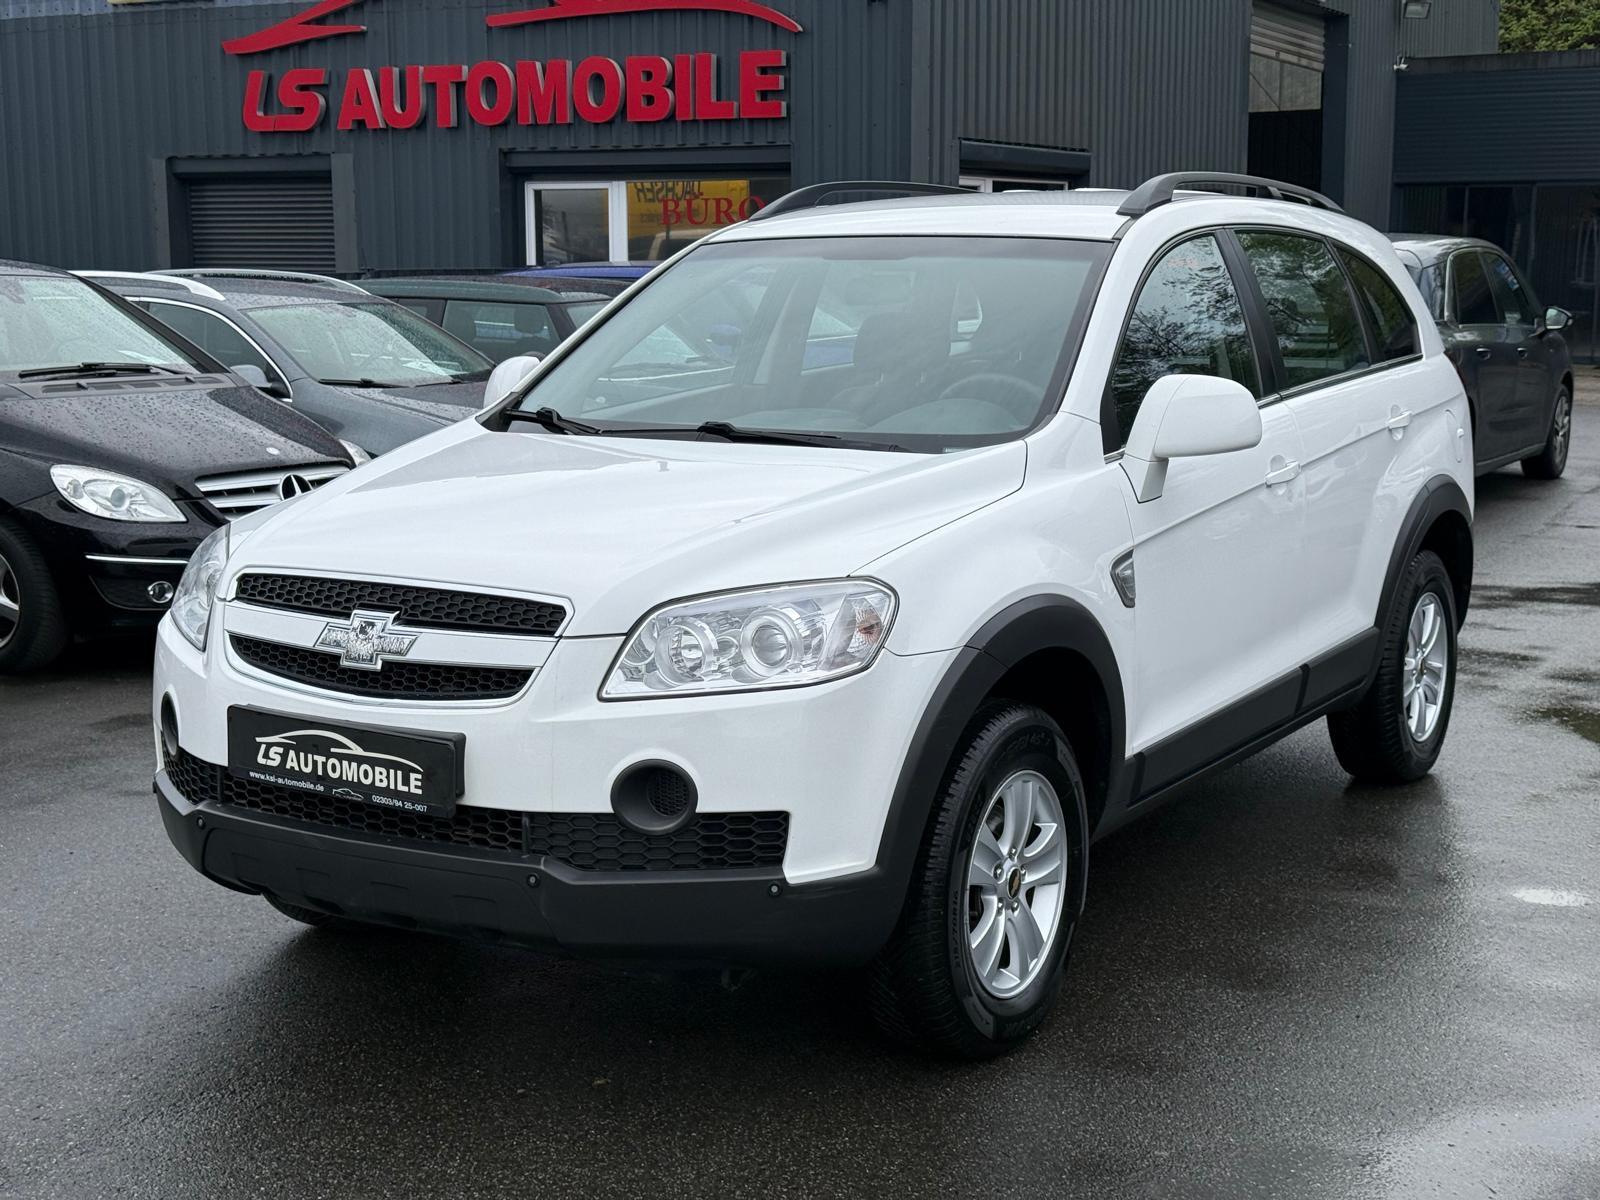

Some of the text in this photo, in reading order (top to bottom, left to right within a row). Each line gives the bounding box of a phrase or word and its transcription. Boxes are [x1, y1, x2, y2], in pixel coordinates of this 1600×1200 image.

[242, 49, 788, 132] LS AUTOMOBILE
[257, 743, 423, 795] LS AUTOMOBILE
